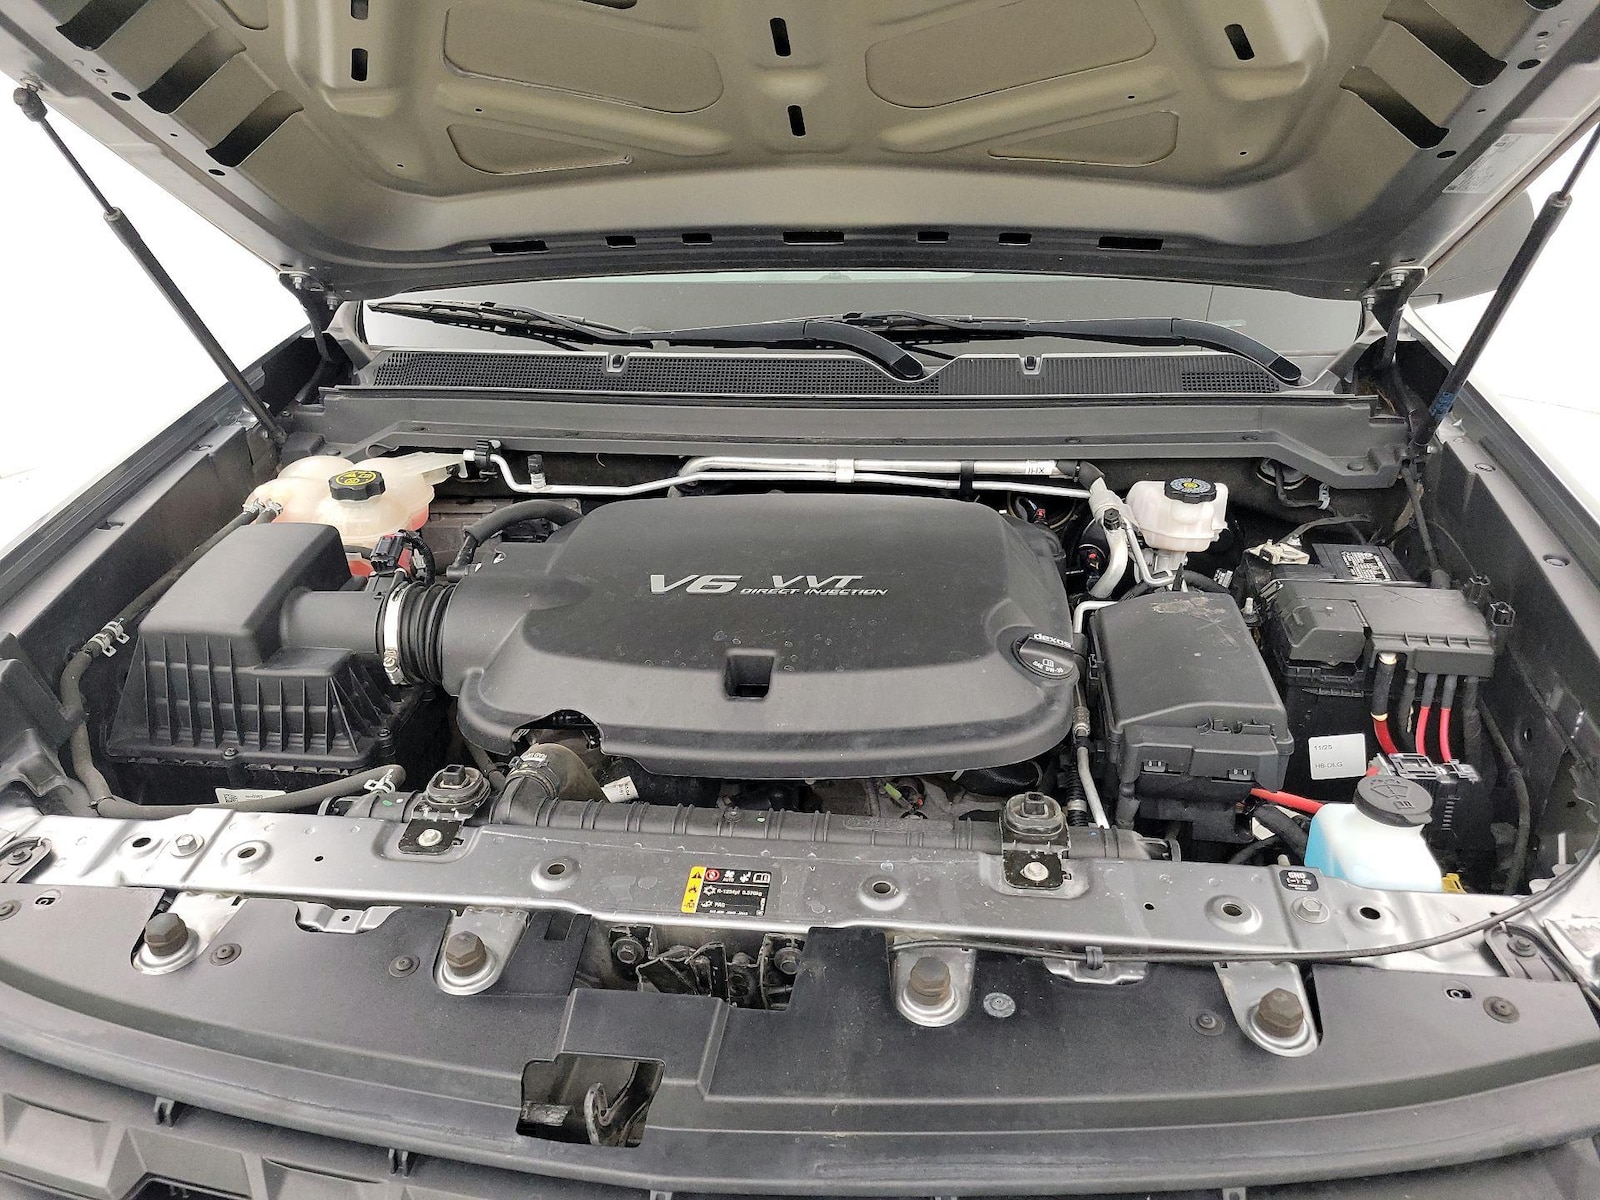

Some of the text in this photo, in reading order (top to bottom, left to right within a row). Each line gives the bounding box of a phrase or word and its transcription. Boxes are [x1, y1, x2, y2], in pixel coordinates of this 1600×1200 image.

[650, 574, 864, 594] V6 VVT
[740, 588, 889, 596] DIRECT INJECTION
[1033, 633, 1072, 648] dexos
